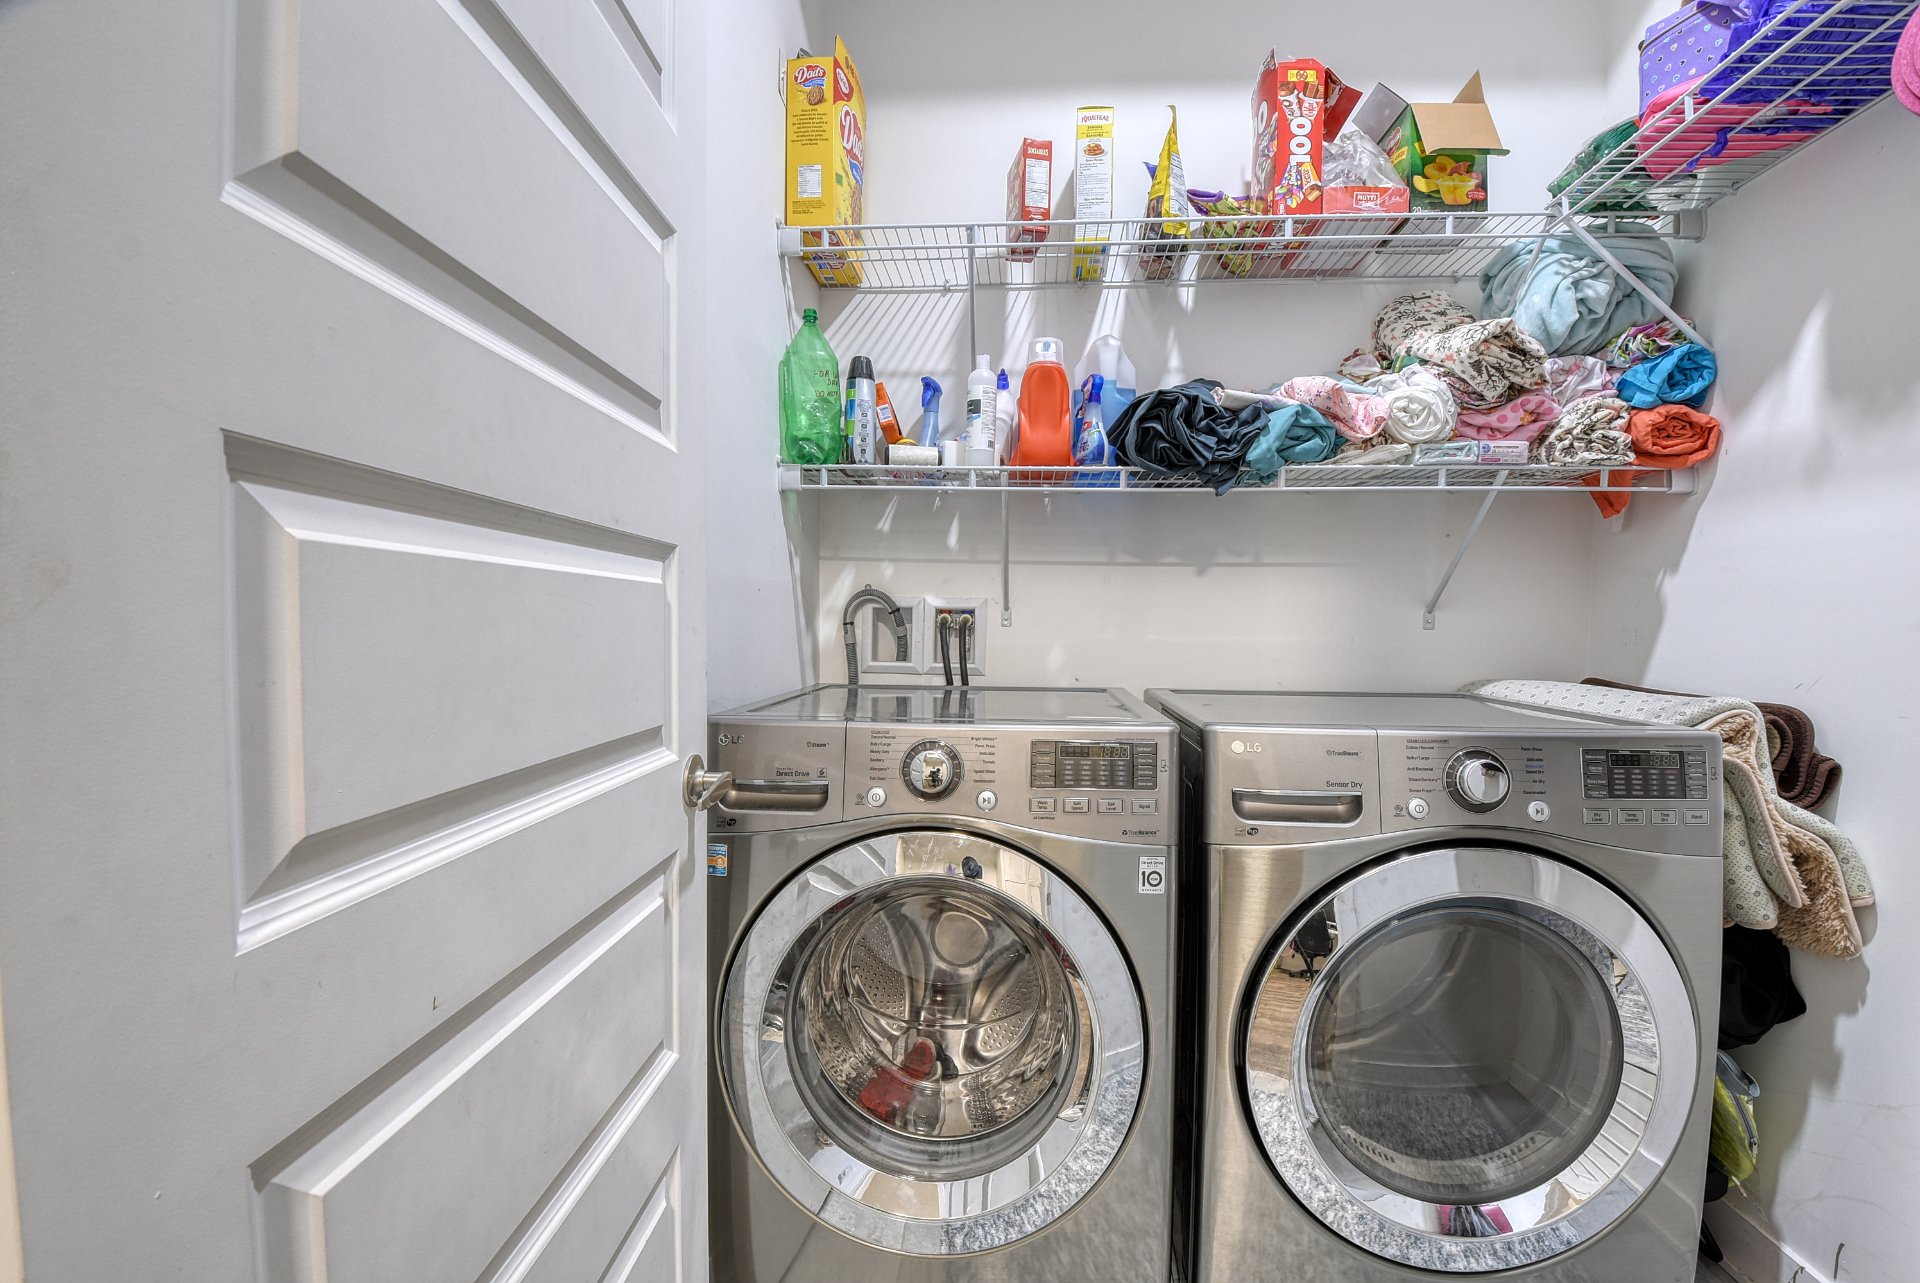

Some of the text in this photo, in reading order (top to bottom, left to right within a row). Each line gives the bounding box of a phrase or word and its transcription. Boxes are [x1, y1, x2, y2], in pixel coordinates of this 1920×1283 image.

[796, 66, 824, 83] Dad's
[1289, 116, 1312, 166] 100
[1247, 743, 1262, 752] LG
[1326, 780, 1362, 789] Sensor Dry
[1141, 870, 1163, 887] 10
